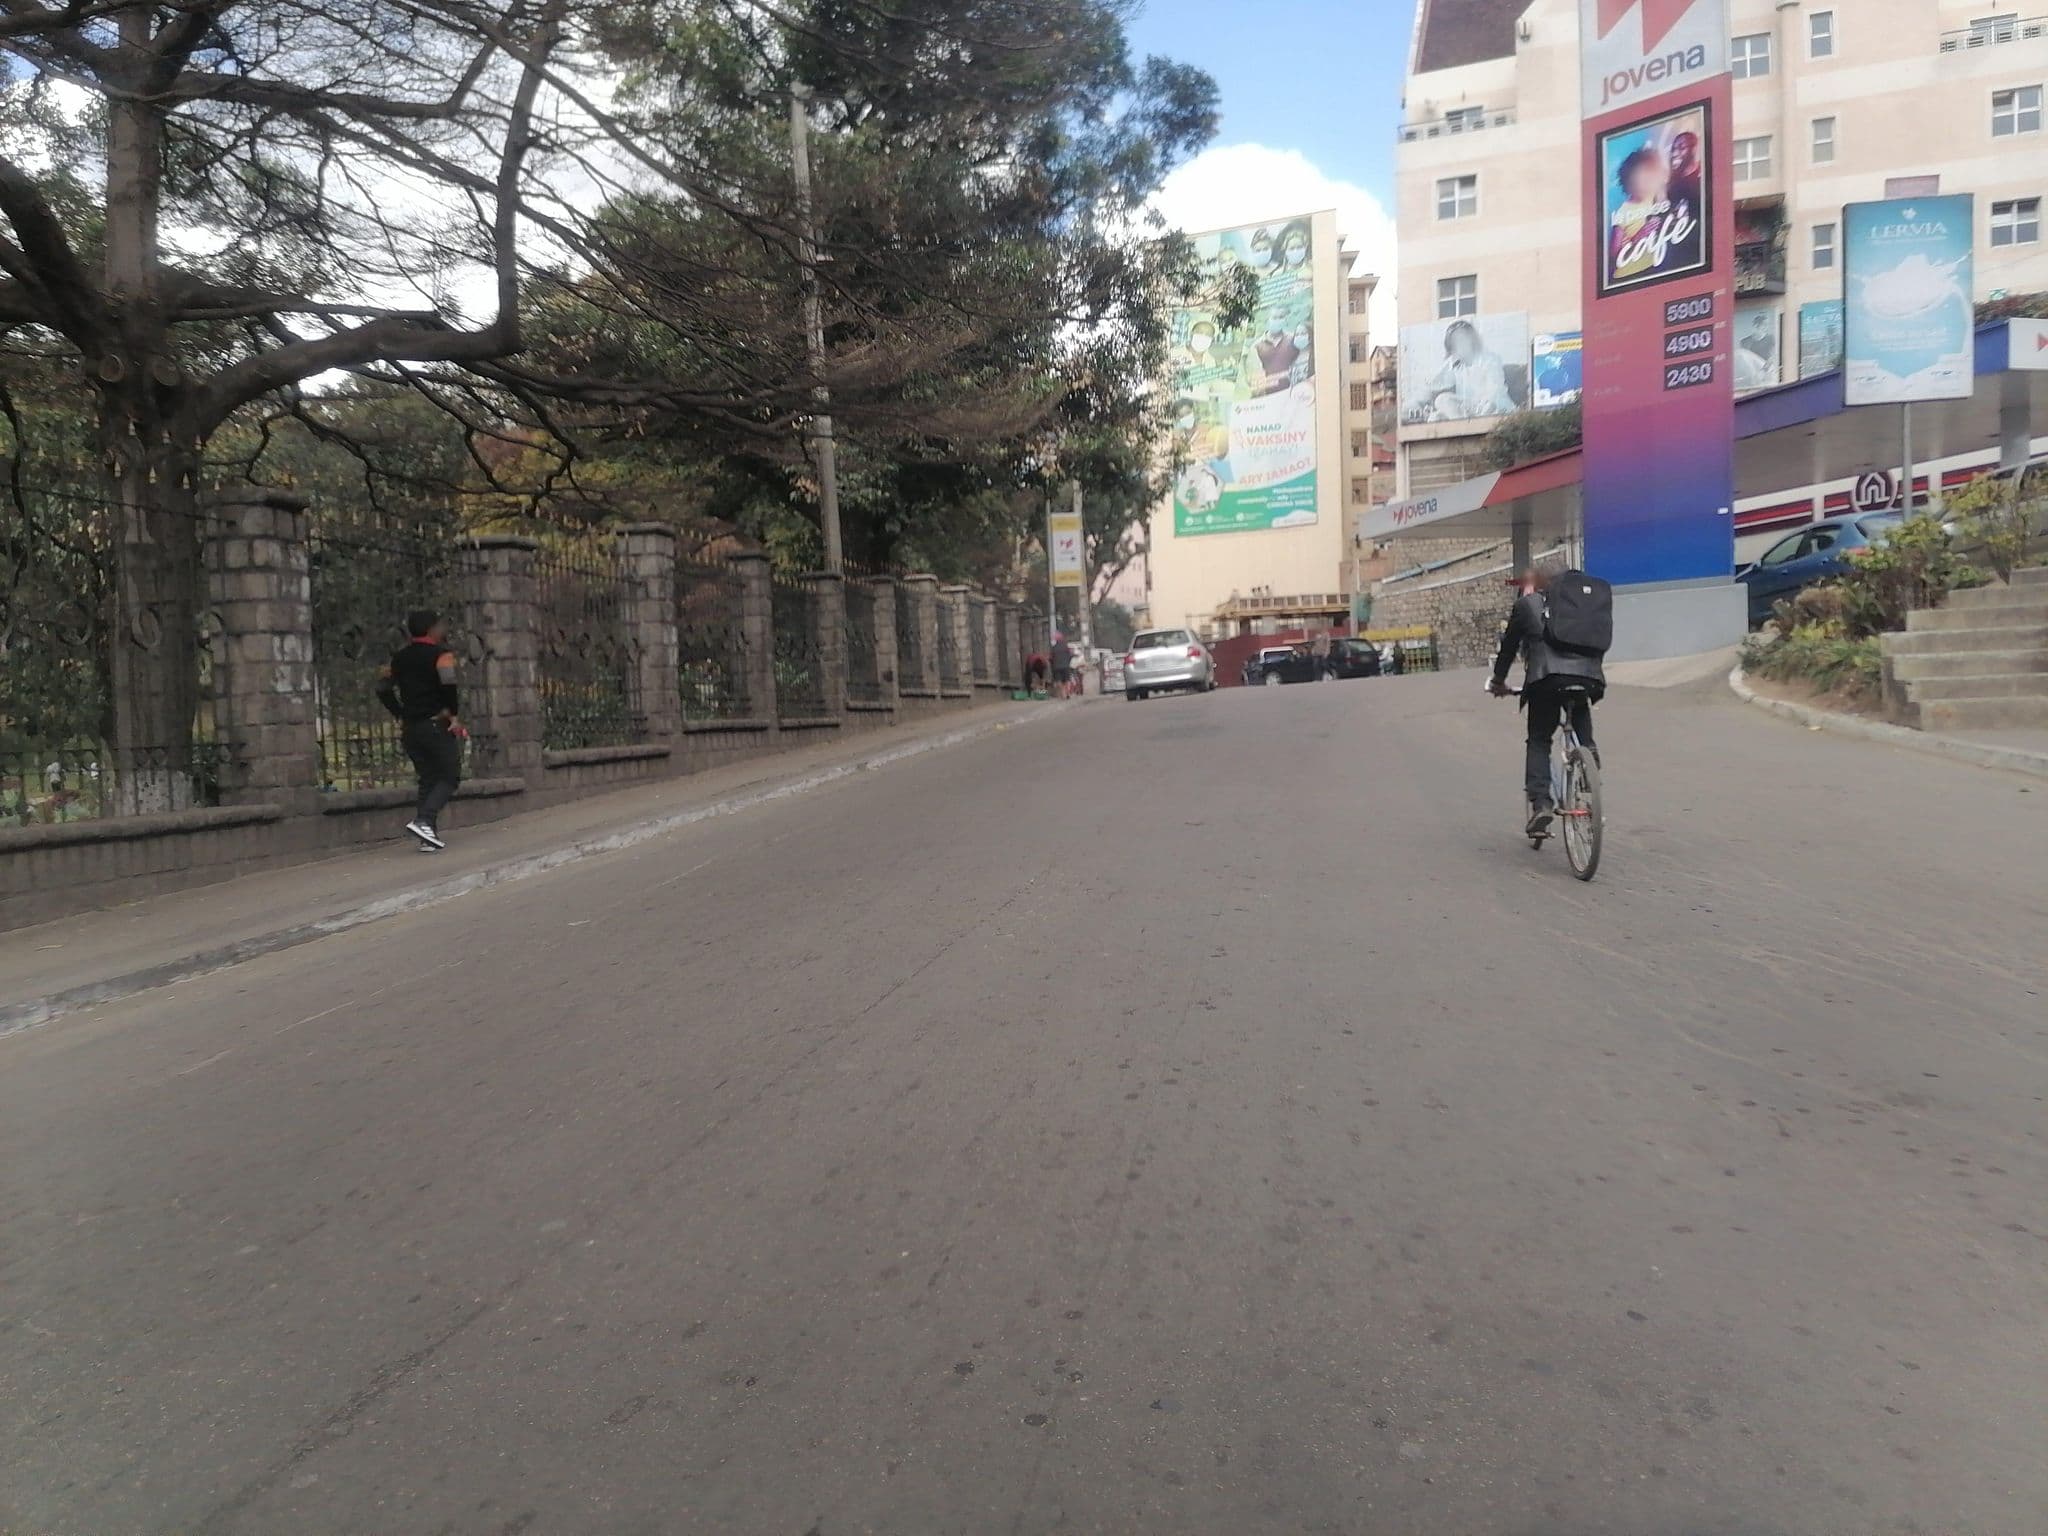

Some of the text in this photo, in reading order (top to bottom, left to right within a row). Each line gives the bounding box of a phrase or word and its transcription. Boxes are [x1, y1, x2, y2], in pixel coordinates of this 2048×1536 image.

[1602, 45, 1705, 105] jovena
[1616, 204, 1697, 269] café
[1667, 298, 1711, 322] 5900
[1666, 331, 1711, 354] 4900
[1667, 363, 1711, 388] 2430
[1246, 431, 1306, 446] VAKSINY
[1403, 498, 1438, 525] jovena
